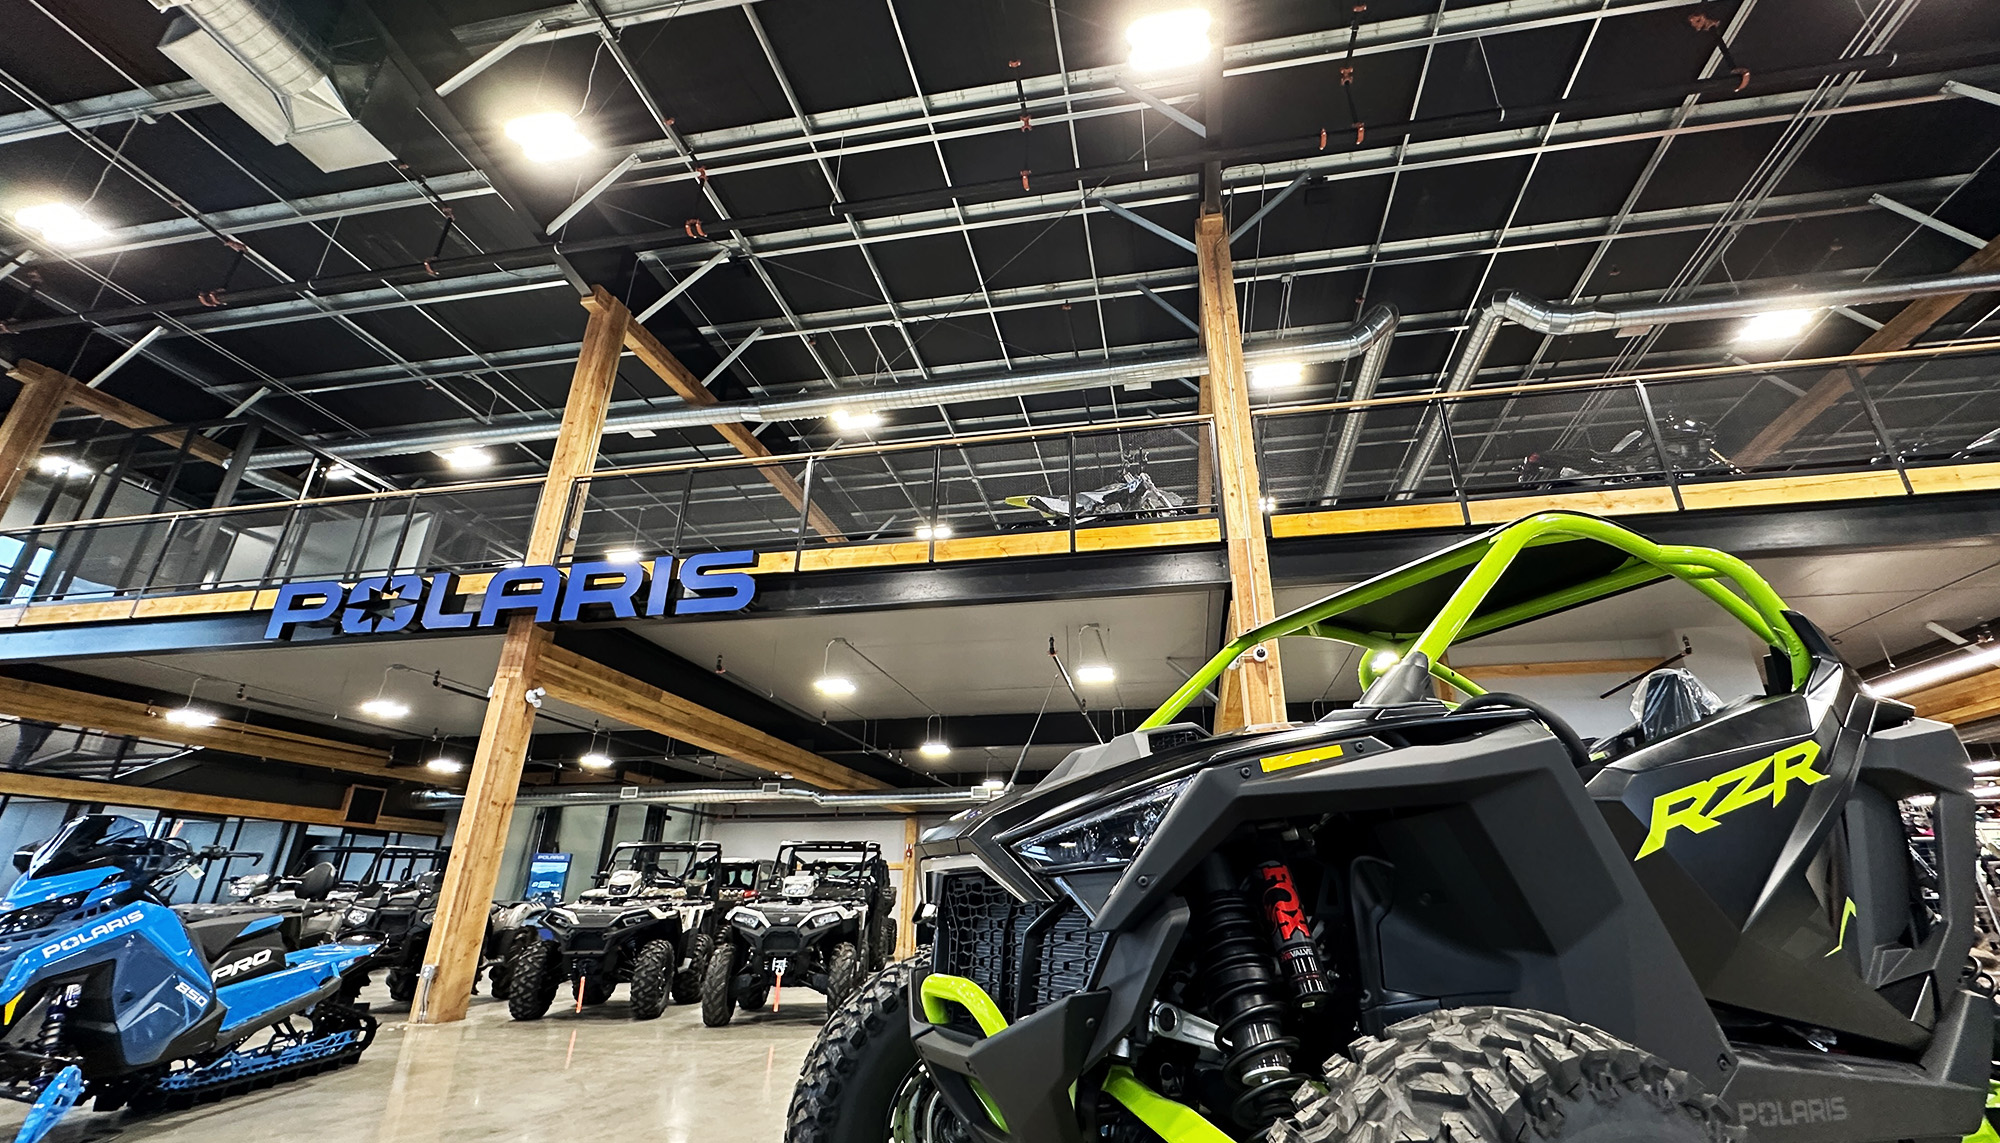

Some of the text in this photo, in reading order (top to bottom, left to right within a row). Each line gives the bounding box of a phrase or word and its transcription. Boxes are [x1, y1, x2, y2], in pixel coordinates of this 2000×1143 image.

[264, 549, 758, 640] POLARIS
[1634, 739, 1831, 862] RZR
[1262, 865, 1312, 941] FOX
[41, 909, 145, 960] POLARIS
[211, 948, 272, 984] PRO
[174, 981, 209, 1008] 850
[1738, 1097, 1849, 1127] POLARIS
